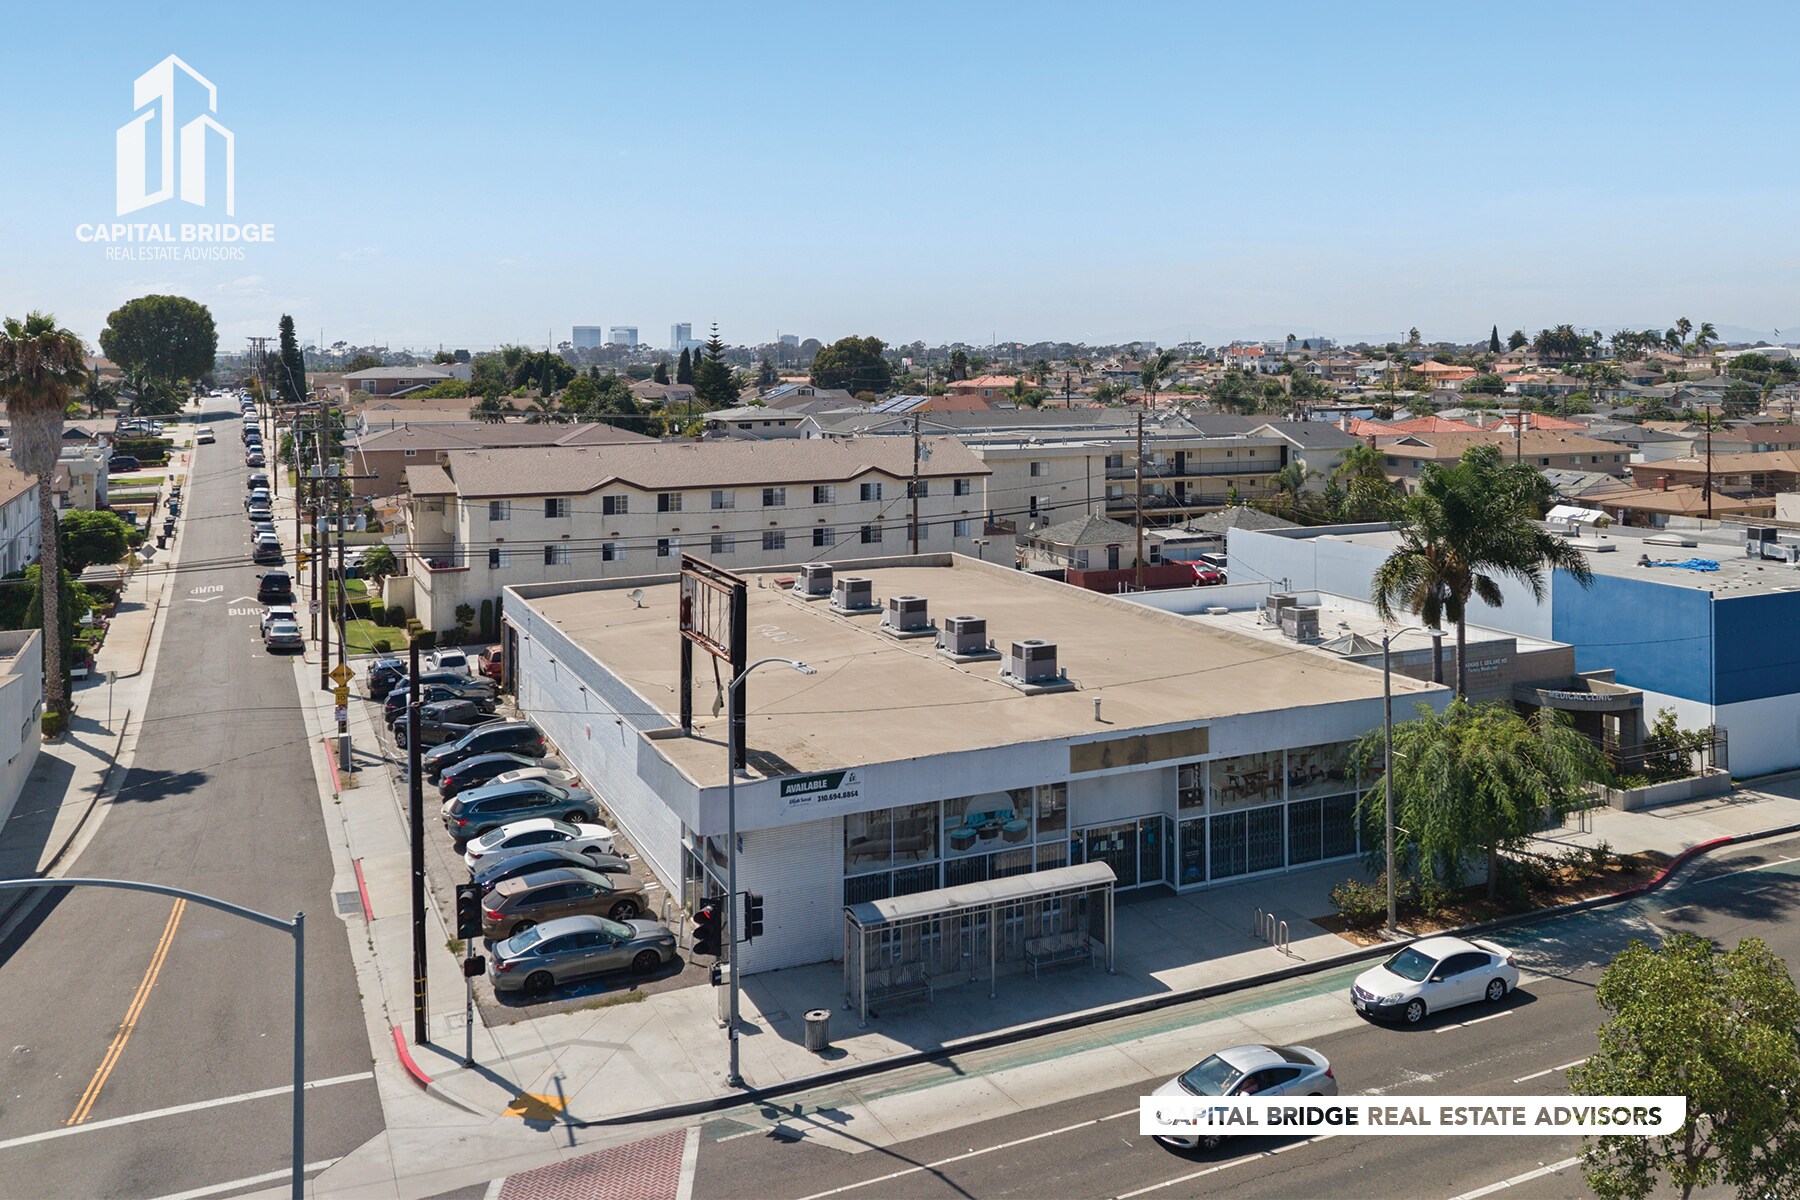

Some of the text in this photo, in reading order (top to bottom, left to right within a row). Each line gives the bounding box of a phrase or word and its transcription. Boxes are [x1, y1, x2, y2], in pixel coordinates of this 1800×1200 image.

[190, 584, 224, 595] BUMP
[228, 608, 263, 616] BUMP
[1548, 690, 1613, 702] MEDICAL CLINIC
[785, 779, 828, 794] AVAILABLE
[817, 790, 859, 803] 310.694.8854
